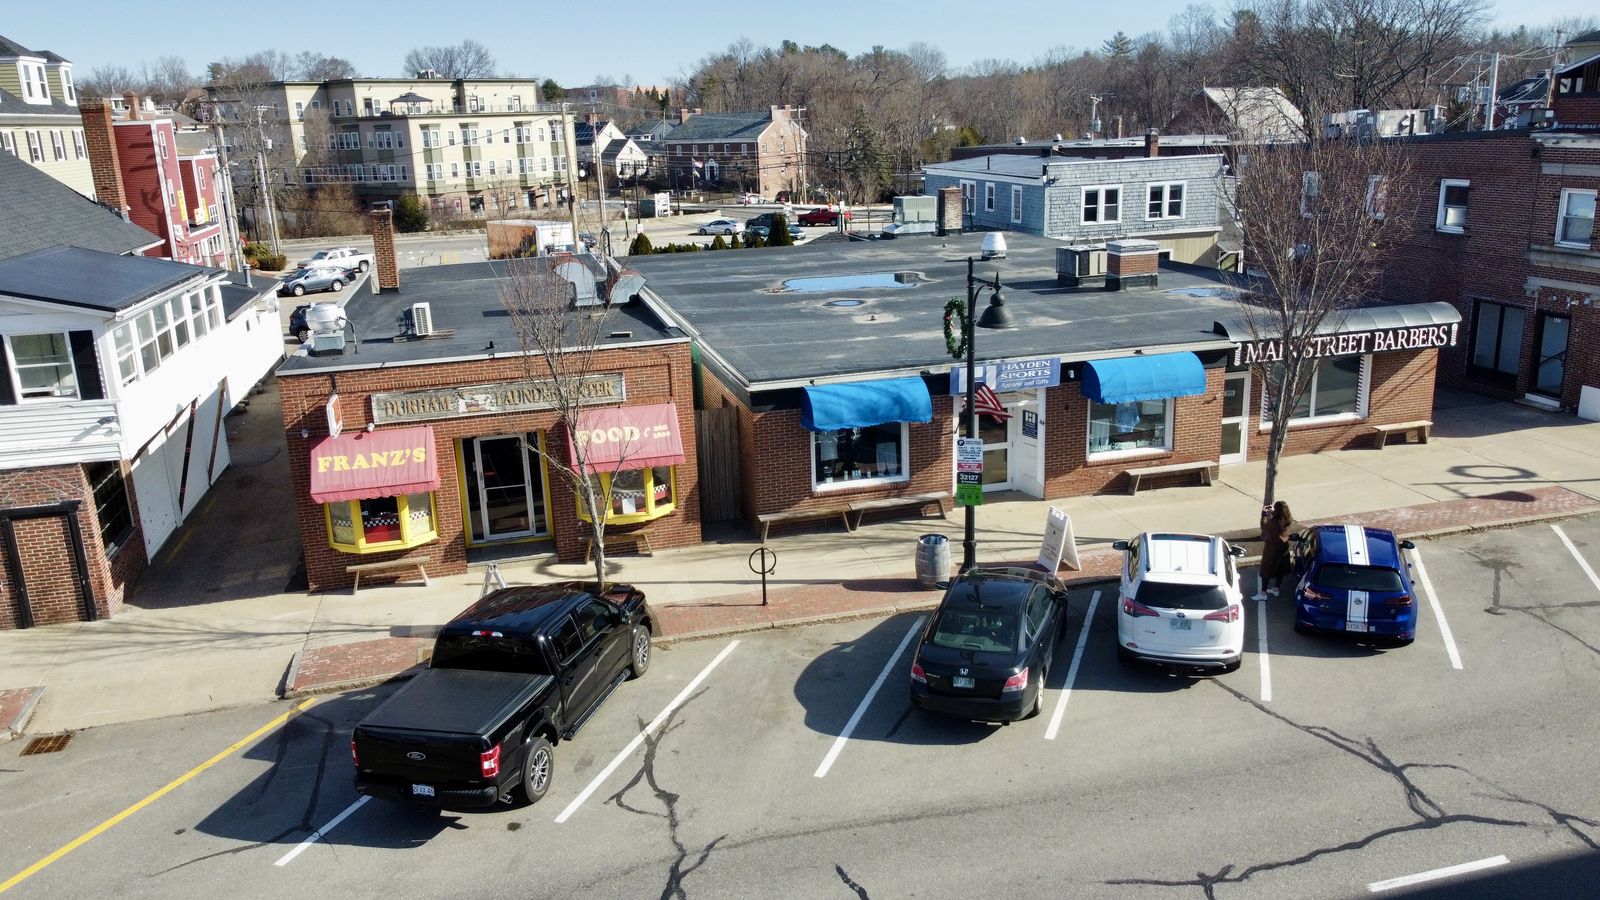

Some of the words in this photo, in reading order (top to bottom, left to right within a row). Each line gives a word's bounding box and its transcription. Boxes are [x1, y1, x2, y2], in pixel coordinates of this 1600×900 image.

[1373, 325, 1448, 351] BARBERS
[1001, 369, 1051, 380] SPORTS
[1002, 360, 1051, 371] HAYDEN
[1024, 379, 1035, 387] and
[385, 395, 453, 416] DURHAM
[575, 425, 641, 446] FOOD
[317, 447, 426, 473] FRANZ'S
